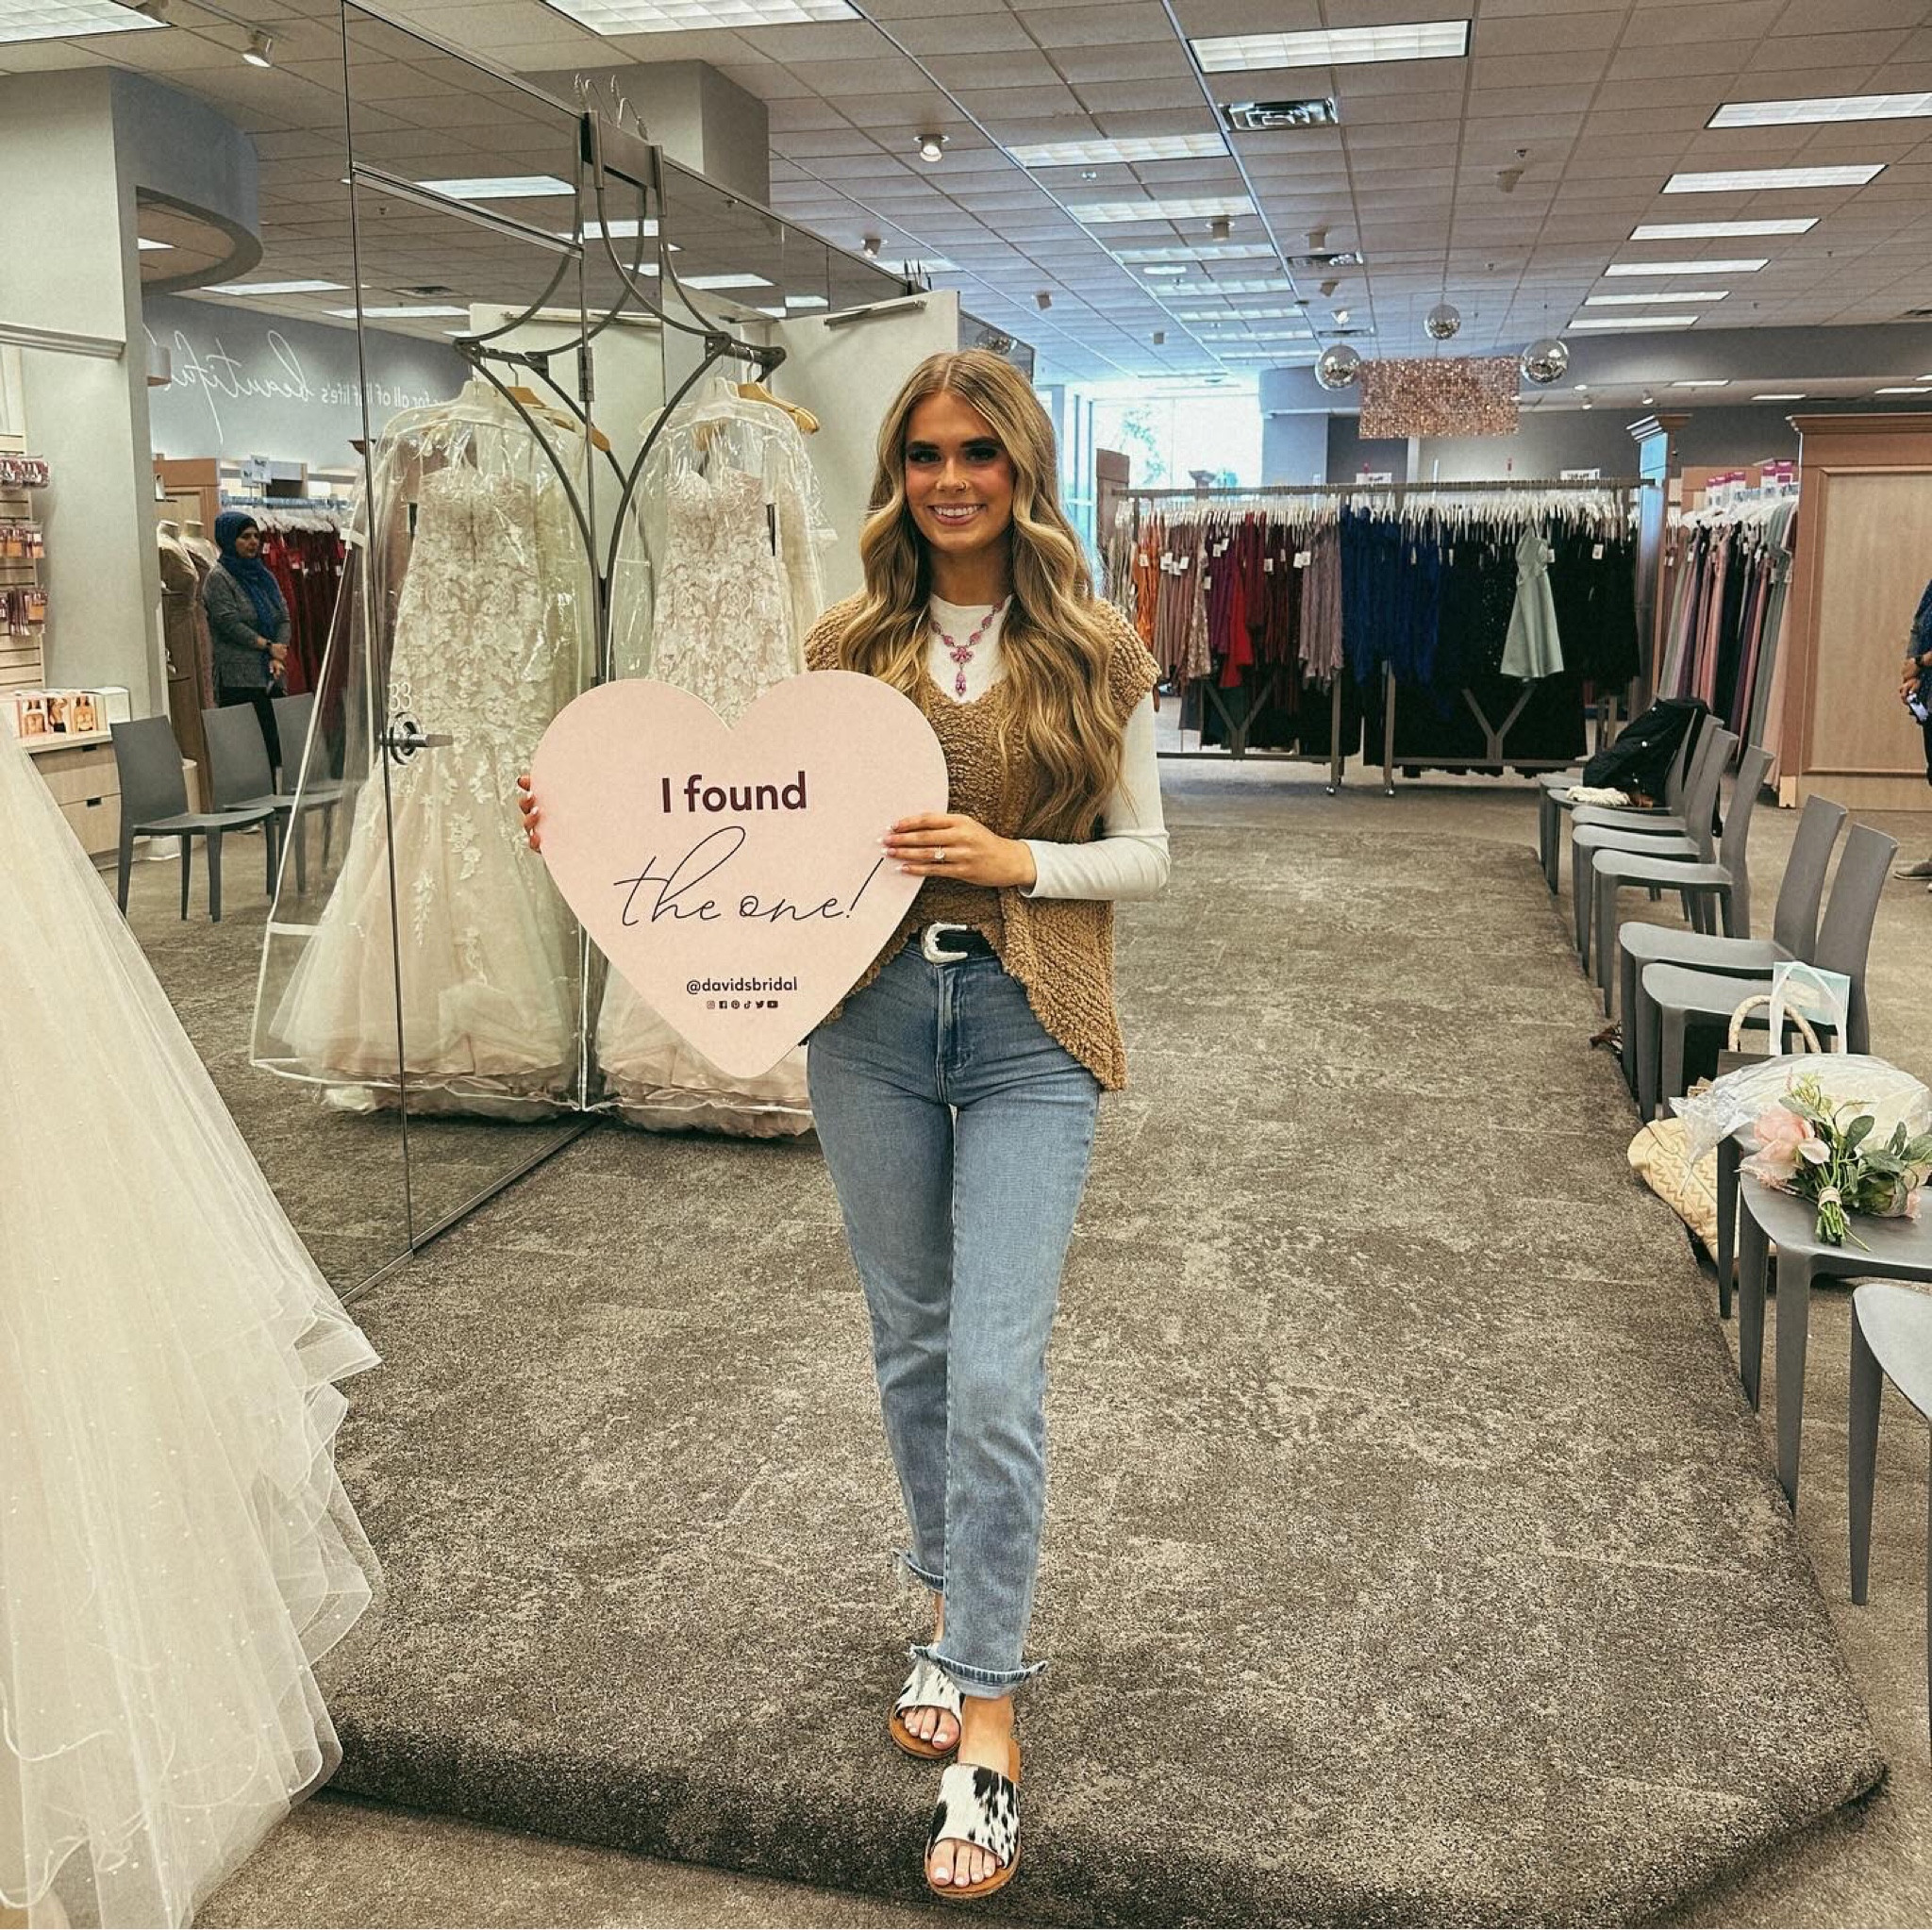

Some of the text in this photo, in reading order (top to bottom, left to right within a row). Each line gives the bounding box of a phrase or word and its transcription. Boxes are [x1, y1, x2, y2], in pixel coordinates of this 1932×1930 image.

[661, 771, 808, 813] I found
[613, 825, 884, 926] the one!
[686, 976, 798, 995] @davidsbridal
